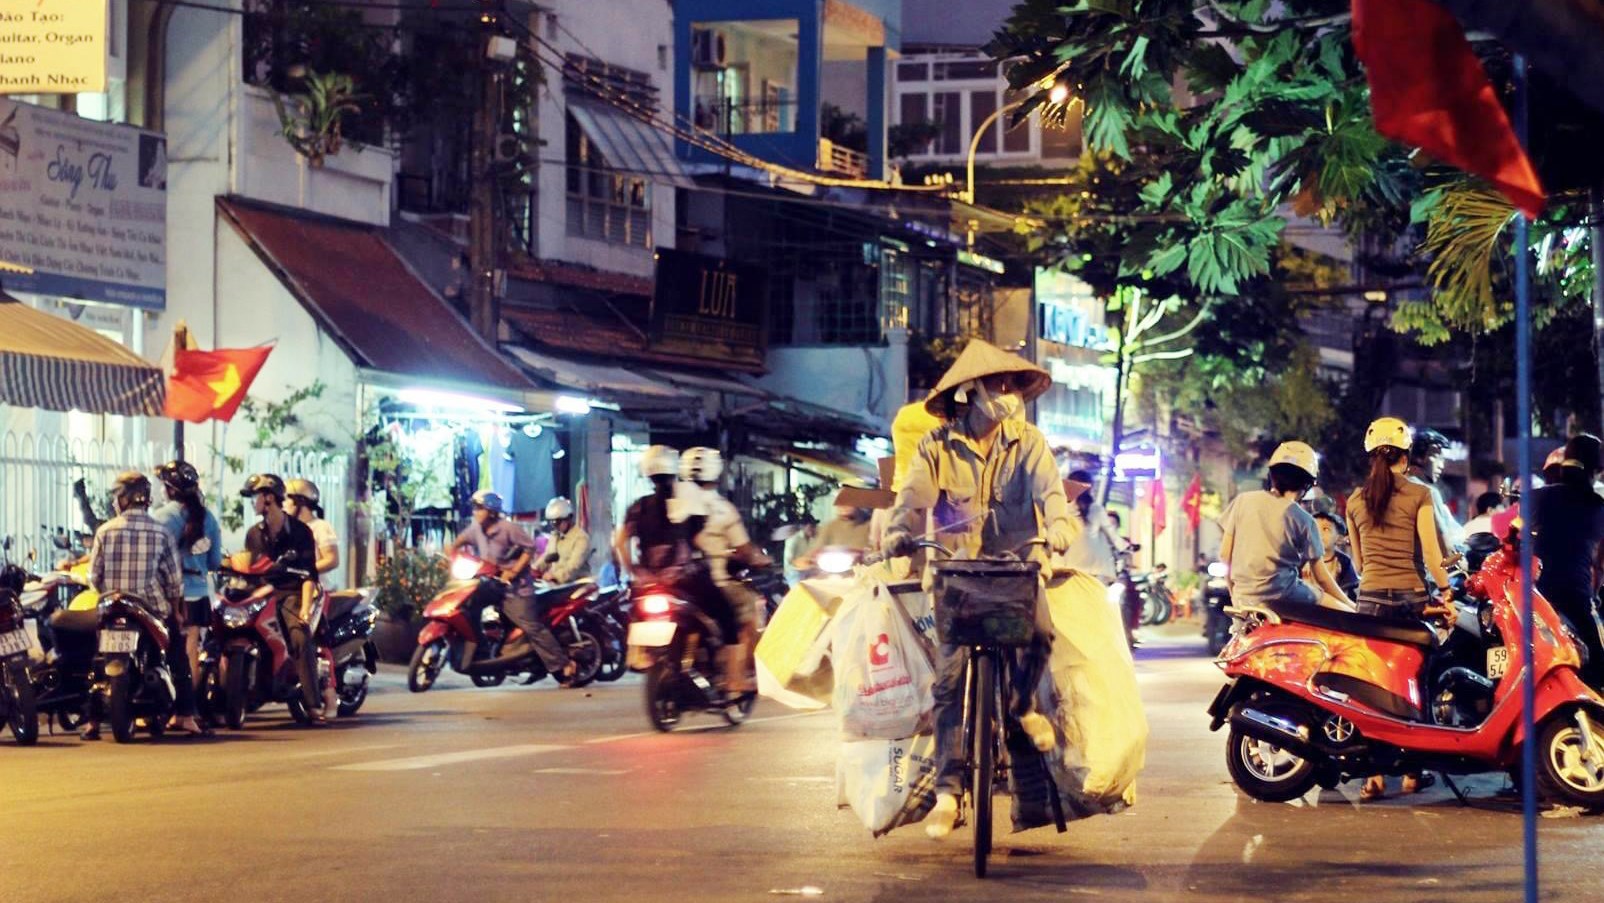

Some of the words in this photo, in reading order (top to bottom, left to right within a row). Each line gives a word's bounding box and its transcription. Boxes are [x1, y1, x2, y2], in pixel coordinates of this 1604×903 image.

[0, 32, 41, 44] uitar,
[46, 32, 93, 45] Organ
[0, 53, 35, 64] iano
[0, 74, 40, 84] hanh
[1494, 649, 1507, 662] 59
[1490, 663, 1508, 676] 54
[893, 746, 903, 794] SUGAR
